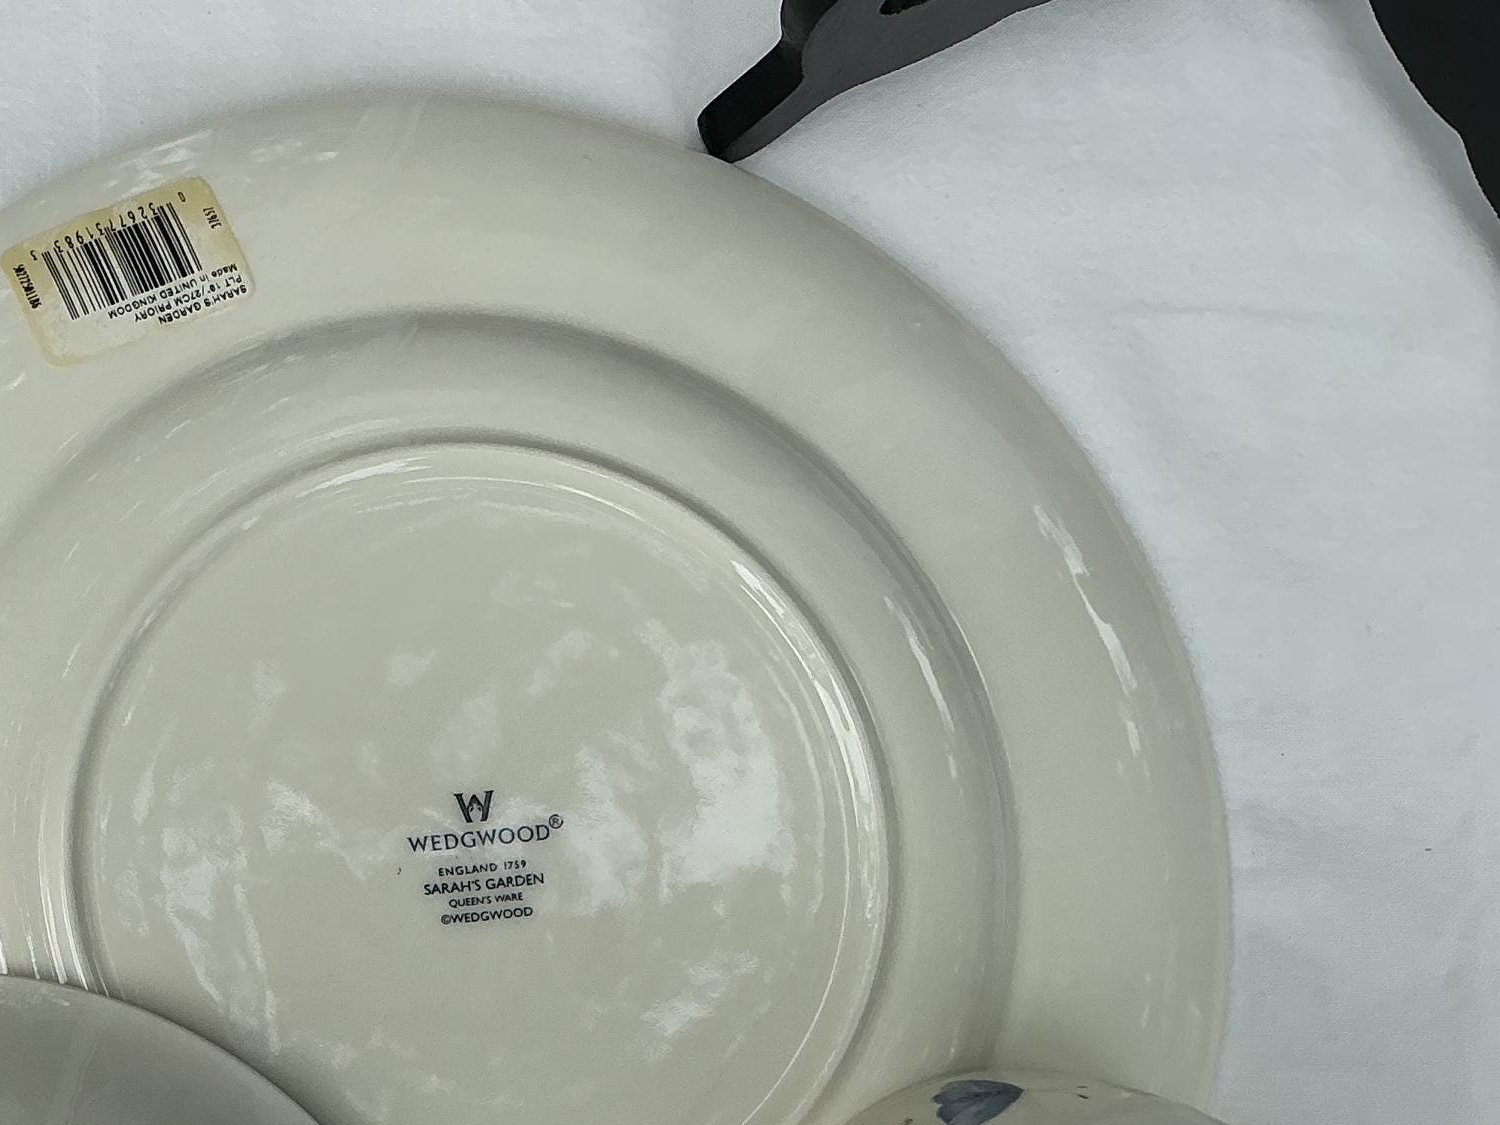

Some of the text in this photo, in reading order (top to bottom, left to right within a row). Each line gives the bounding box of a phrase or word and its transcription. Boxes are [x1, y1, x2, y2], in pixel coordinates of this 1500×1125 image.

[107, 263, 238, 320] Made in UNITED KINGDOM
[224, 274, 243, 288] PLT
[134, 300, 173, 323] PRIORY
[157, 284, 247, 325] SARAH'S GARDEN
[438, 859, 527, 877] ENGLAND 1759
[423, 872, 545, 896] SARAH'S GARDEN
[448, 891, 524, 909] QUEEN'S WARE
